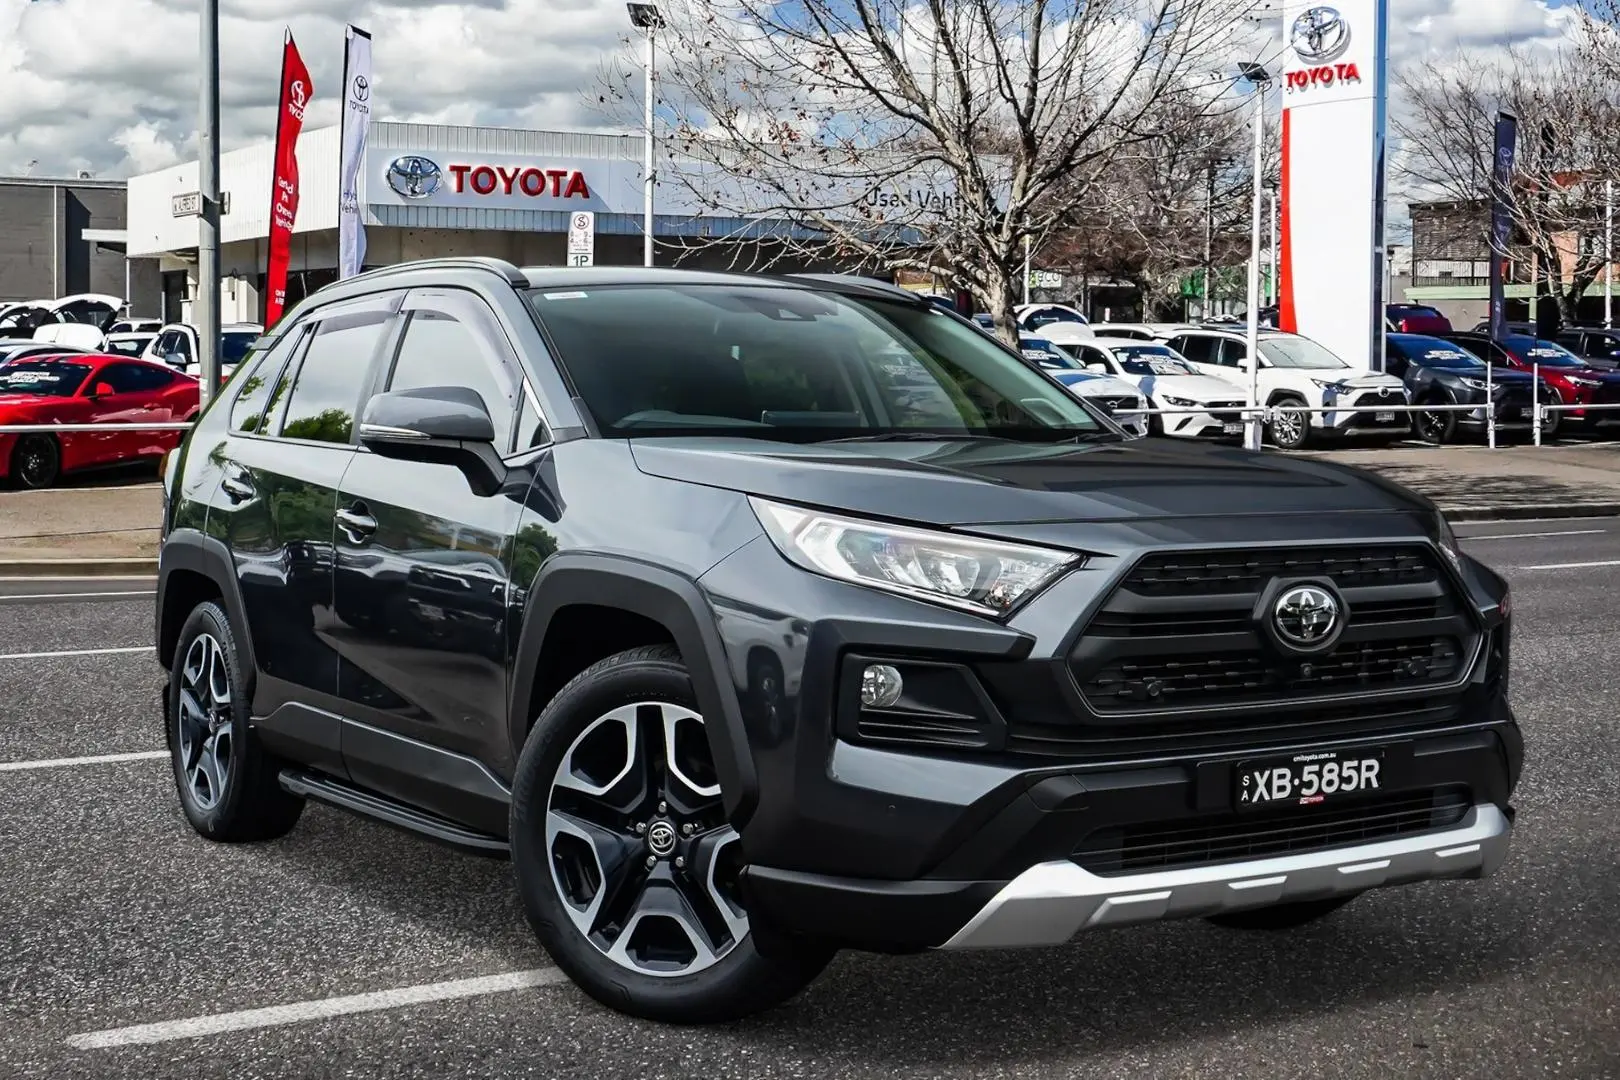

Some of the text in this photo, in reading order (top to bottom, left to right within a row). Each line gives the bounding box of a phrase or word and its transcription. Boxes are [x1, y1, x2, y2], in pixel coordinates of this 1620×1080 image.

[1285, 63, 1360, 88] TOYOTA
[448, 165, 590, 199] TOYOTA
[572, 255, 589, 267] 1P
